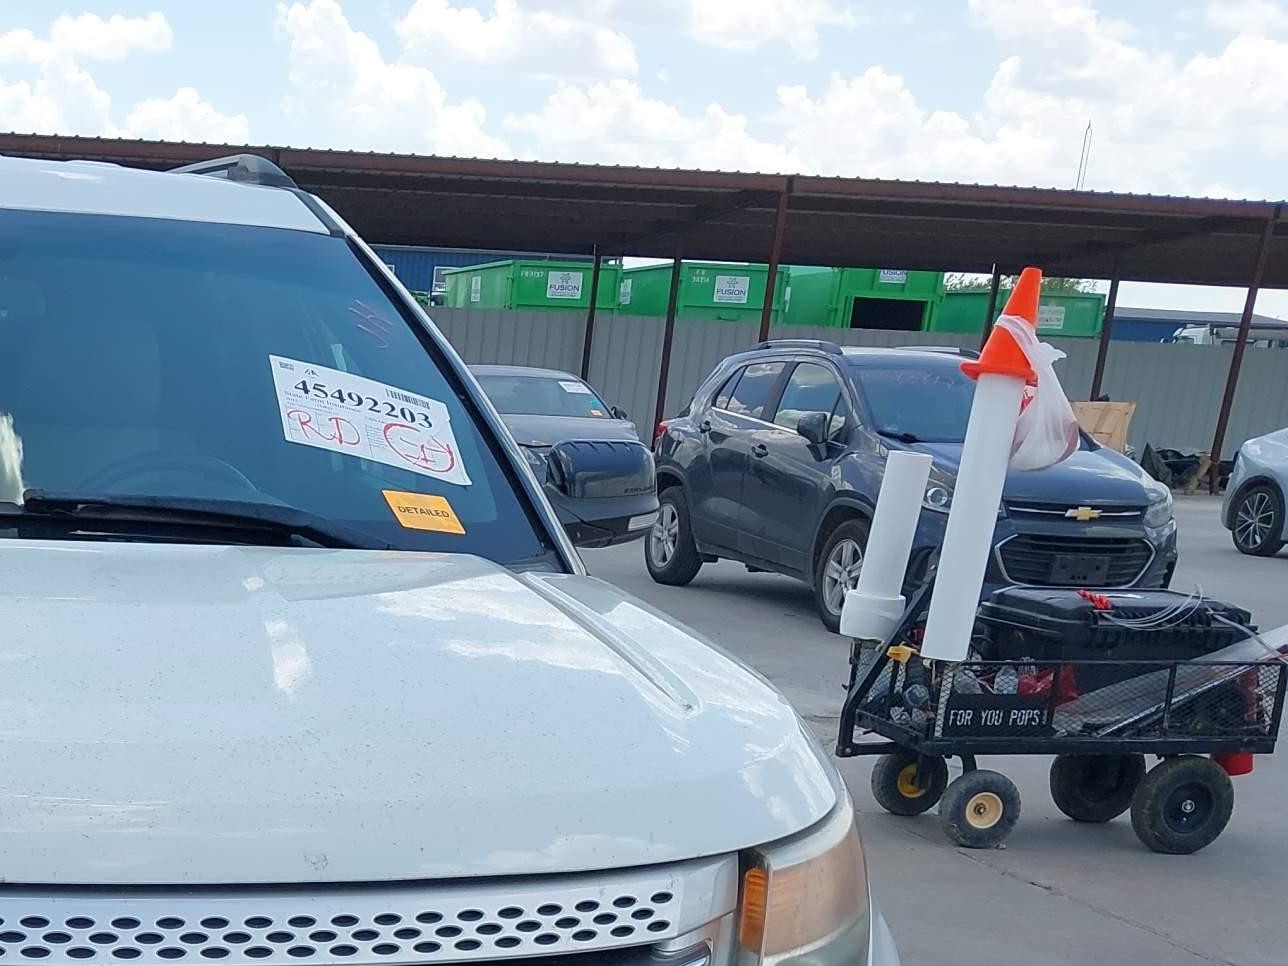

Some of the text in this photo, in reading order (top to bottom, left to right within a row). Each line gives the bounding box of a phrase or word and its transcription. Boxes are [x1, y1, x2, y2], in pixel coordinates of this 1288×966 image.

[549, 283, 580, 292] FUSION
[716, 288, 746, 297] FUSION
[294, 379, 433, 428] 45492203
[397, 505, 450, 519] DETAILED
[948, 709, 974, 726] FOR
[980, 709, 1004, 726] YOU
